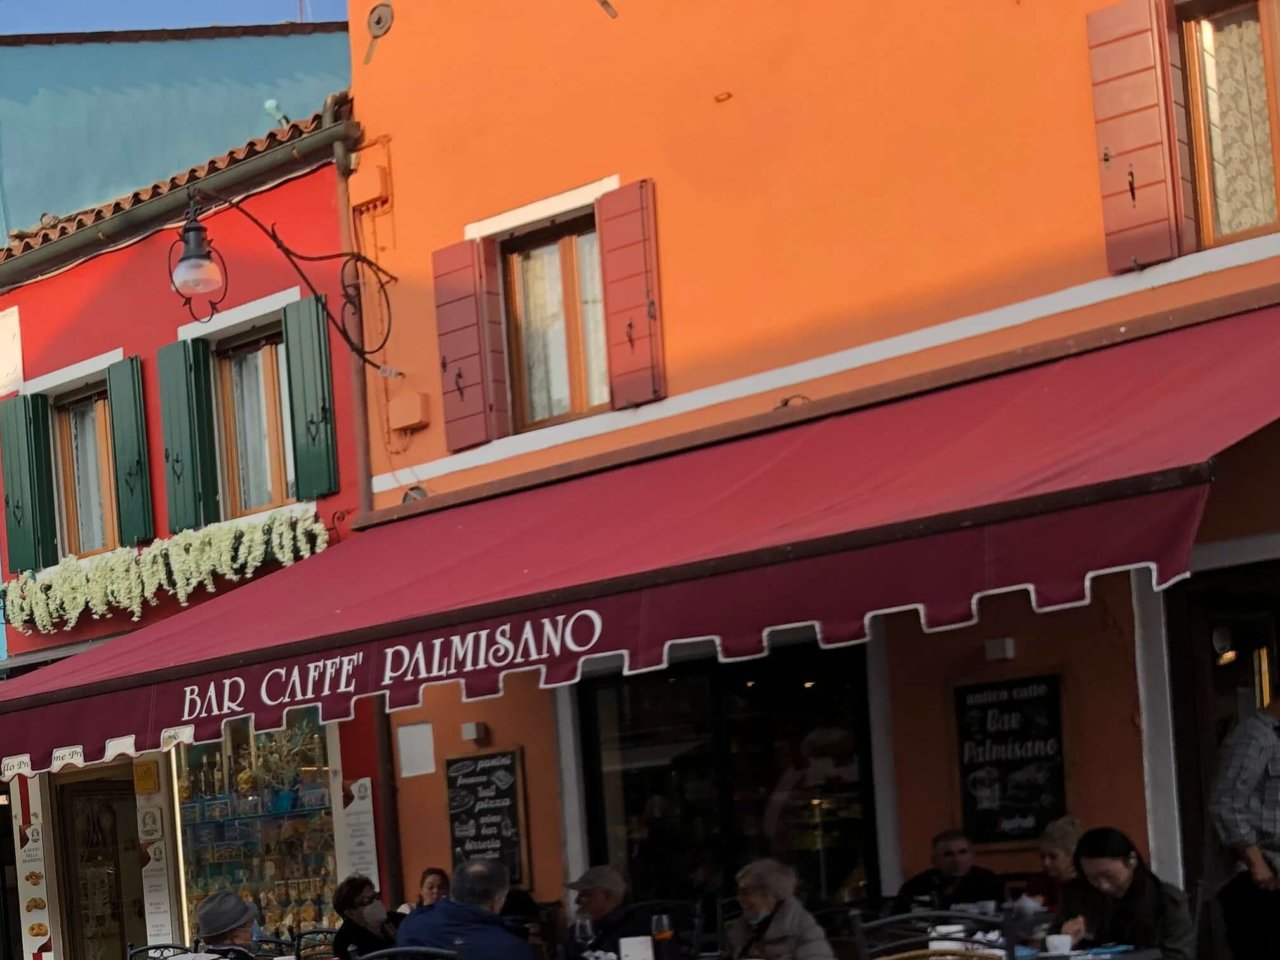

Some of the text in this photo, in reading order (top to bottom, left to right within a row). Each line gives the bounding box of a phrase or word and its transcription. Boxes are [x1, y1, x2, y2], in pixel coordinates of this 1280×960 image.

[181, 677, 246, 721] BAR
[381, 609, 603, 686] PALMISANO
[963, 737, 1058, 764] Palmisano
